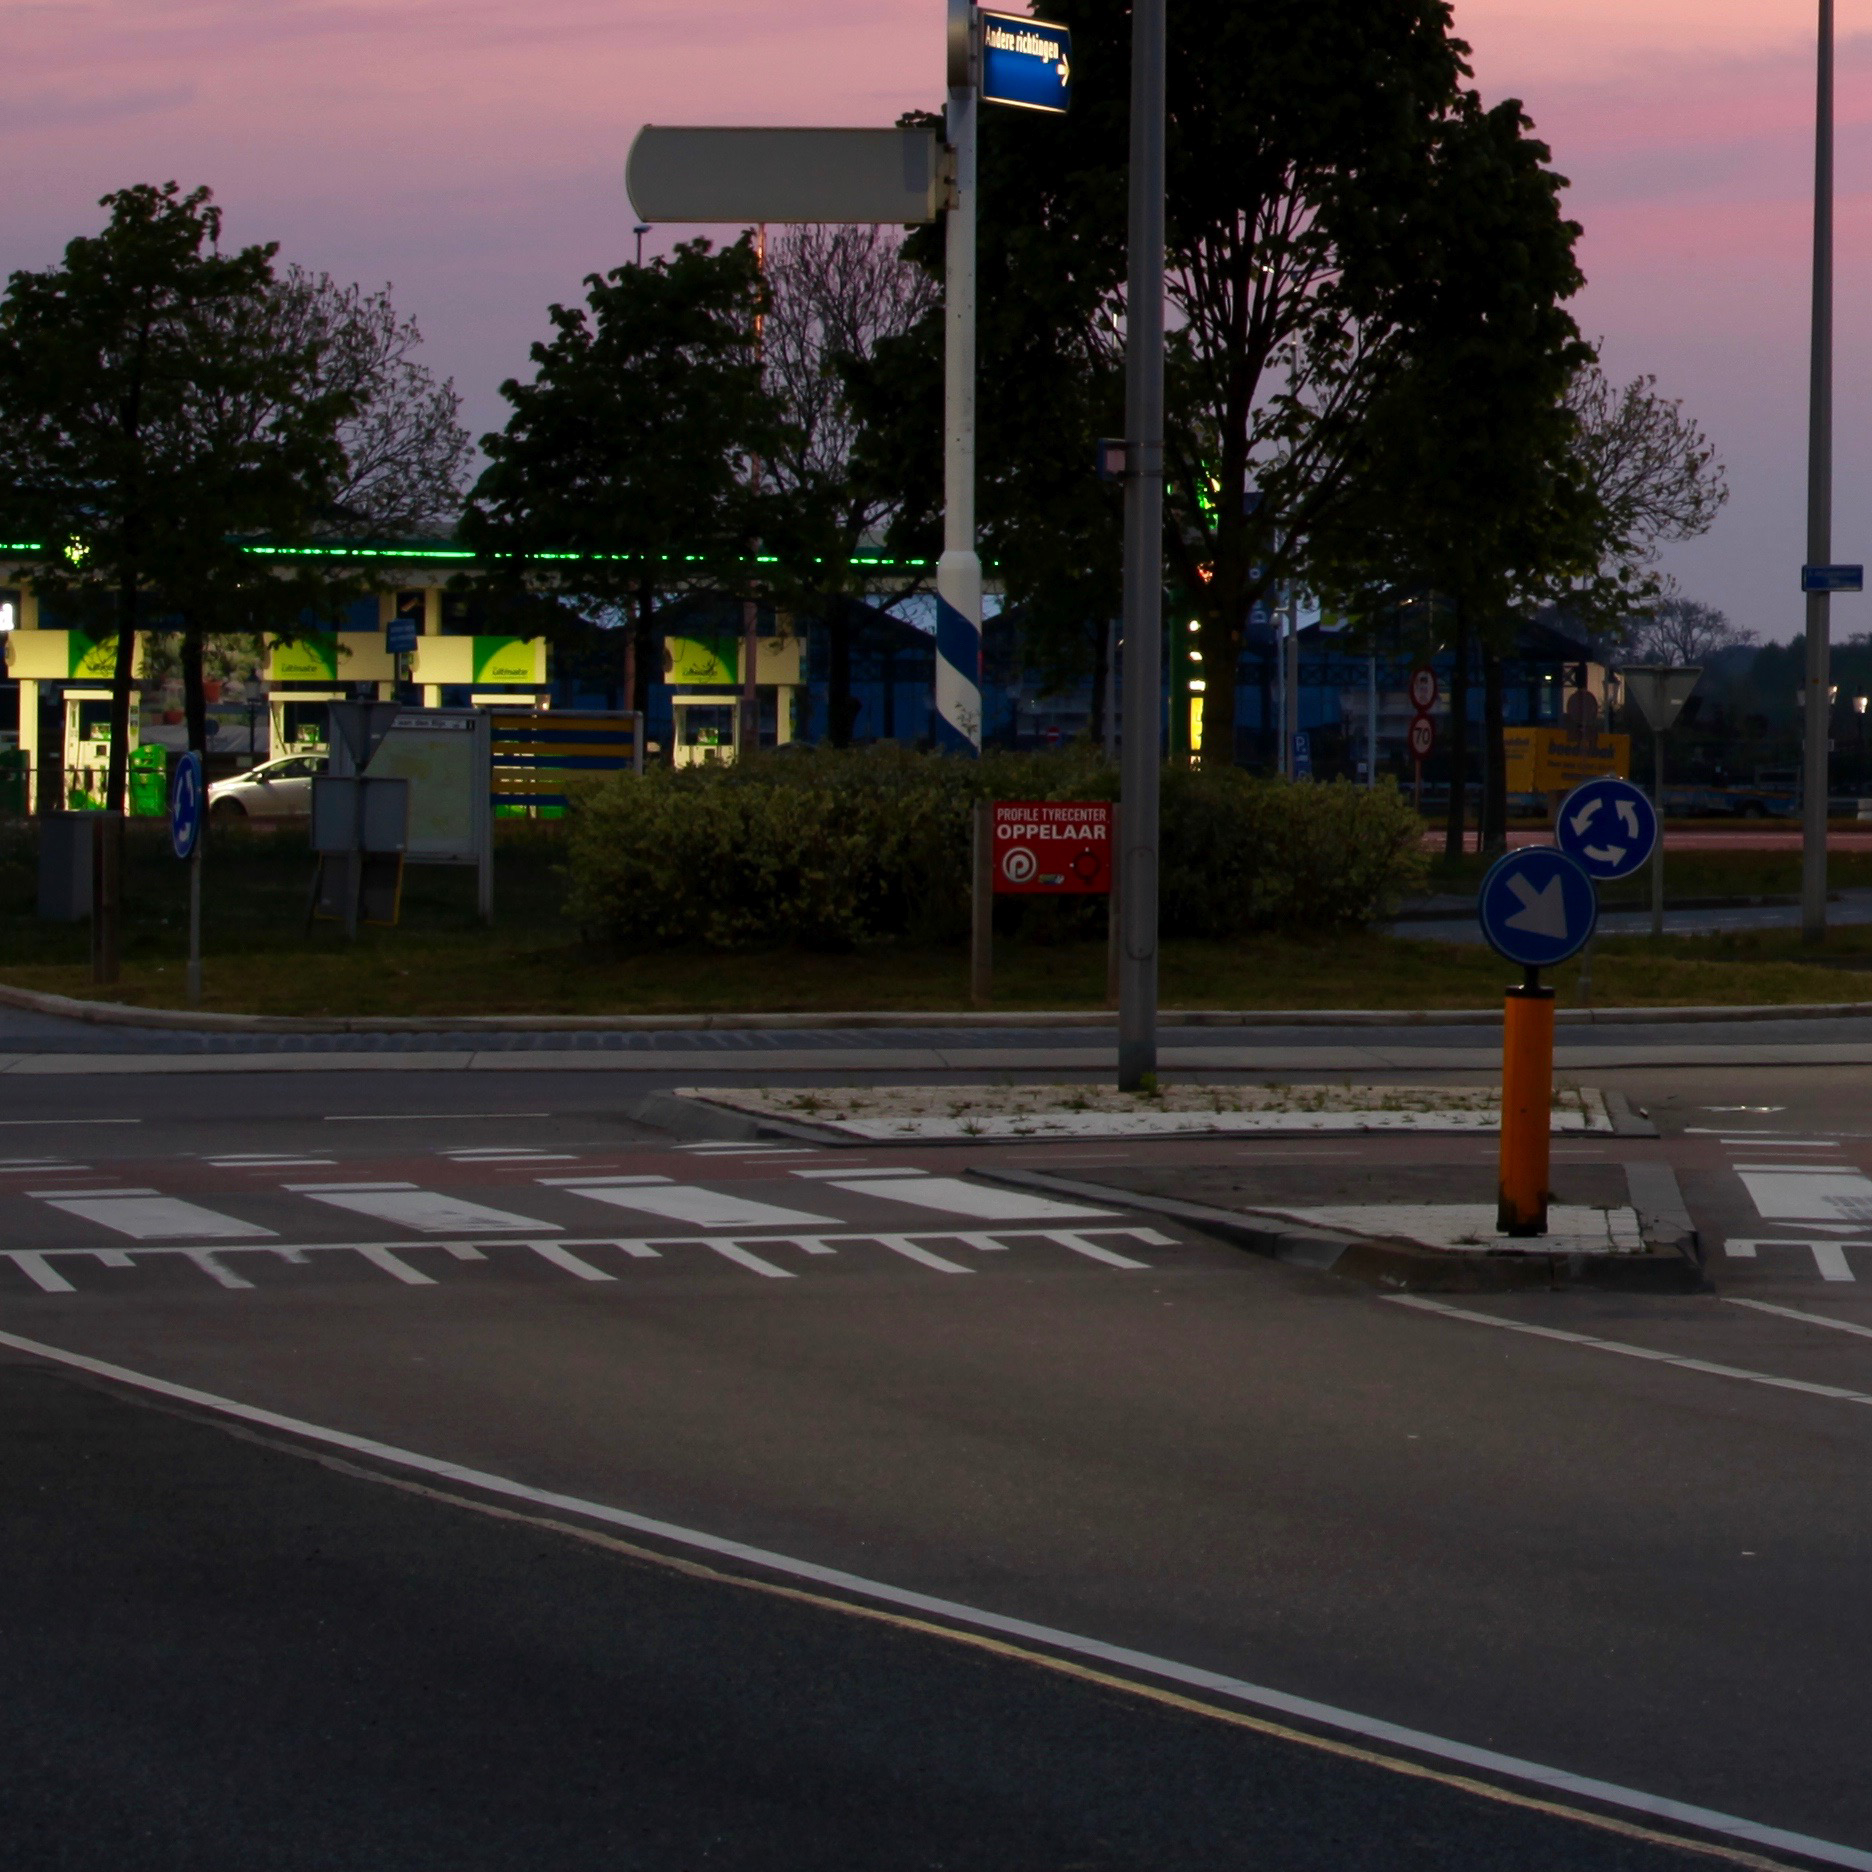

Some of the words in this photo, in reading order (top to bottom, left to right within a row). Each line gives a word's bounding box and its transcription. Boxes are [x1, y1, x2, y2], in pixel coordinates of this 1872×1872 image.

[985, 24, 1015, 50] Andere
[1015, 30, 1060, 64] richtingen
[1414, 727, 1431, 745] 70
[997, 808, 1039, 822] PROFILE
[1042, 808, 1106, 822] TYRECENTER
[996, 824, 1107, 840] OPPELAAR
